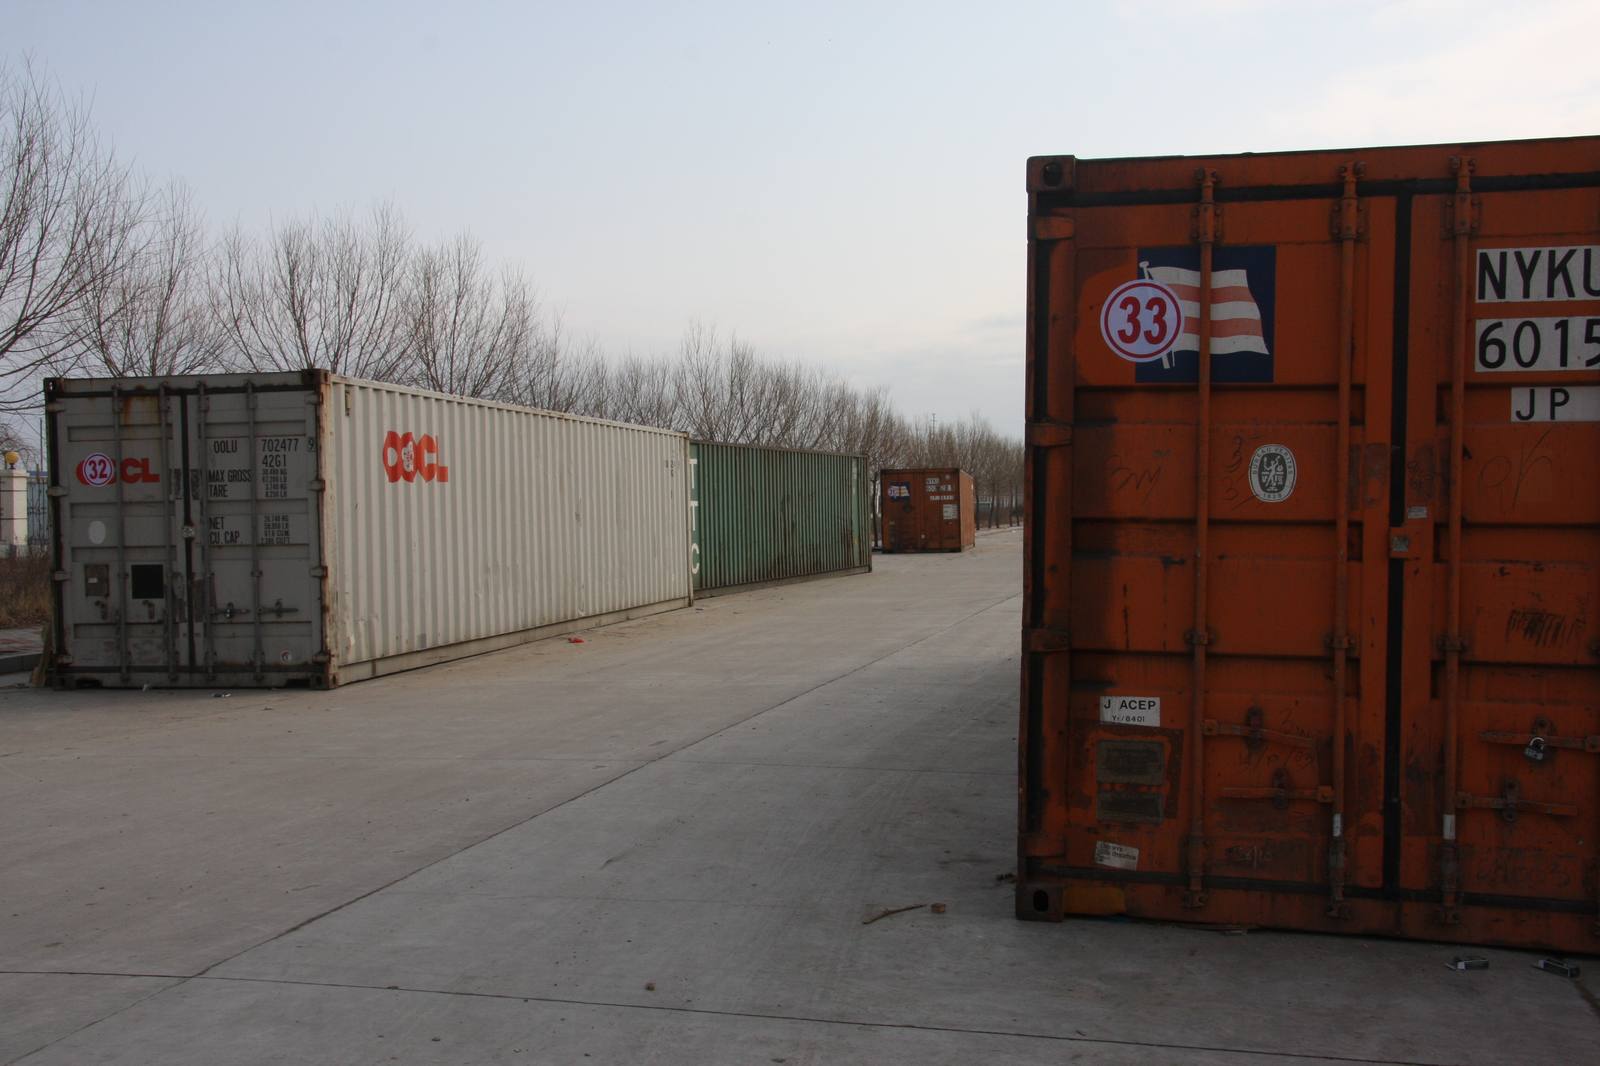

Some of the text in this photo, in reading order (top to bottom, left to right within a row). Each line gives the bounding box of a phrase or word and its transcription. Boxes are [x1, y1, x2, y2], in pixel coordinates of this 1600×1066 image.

[1117, 296, 1168, 345] 33
[262, 438, 299, 452] 702477
[262, 454, 287, 468] 42G1
[88, 460, 108, 480] 32
[208, 469, 225, 482] MAX
[227, 469, 252, 482] GROSS
[209, 484, 228, 497] TARE
[209, 516, 224, 530] NET
[1104, 699, 1156, 710] J ACEP
